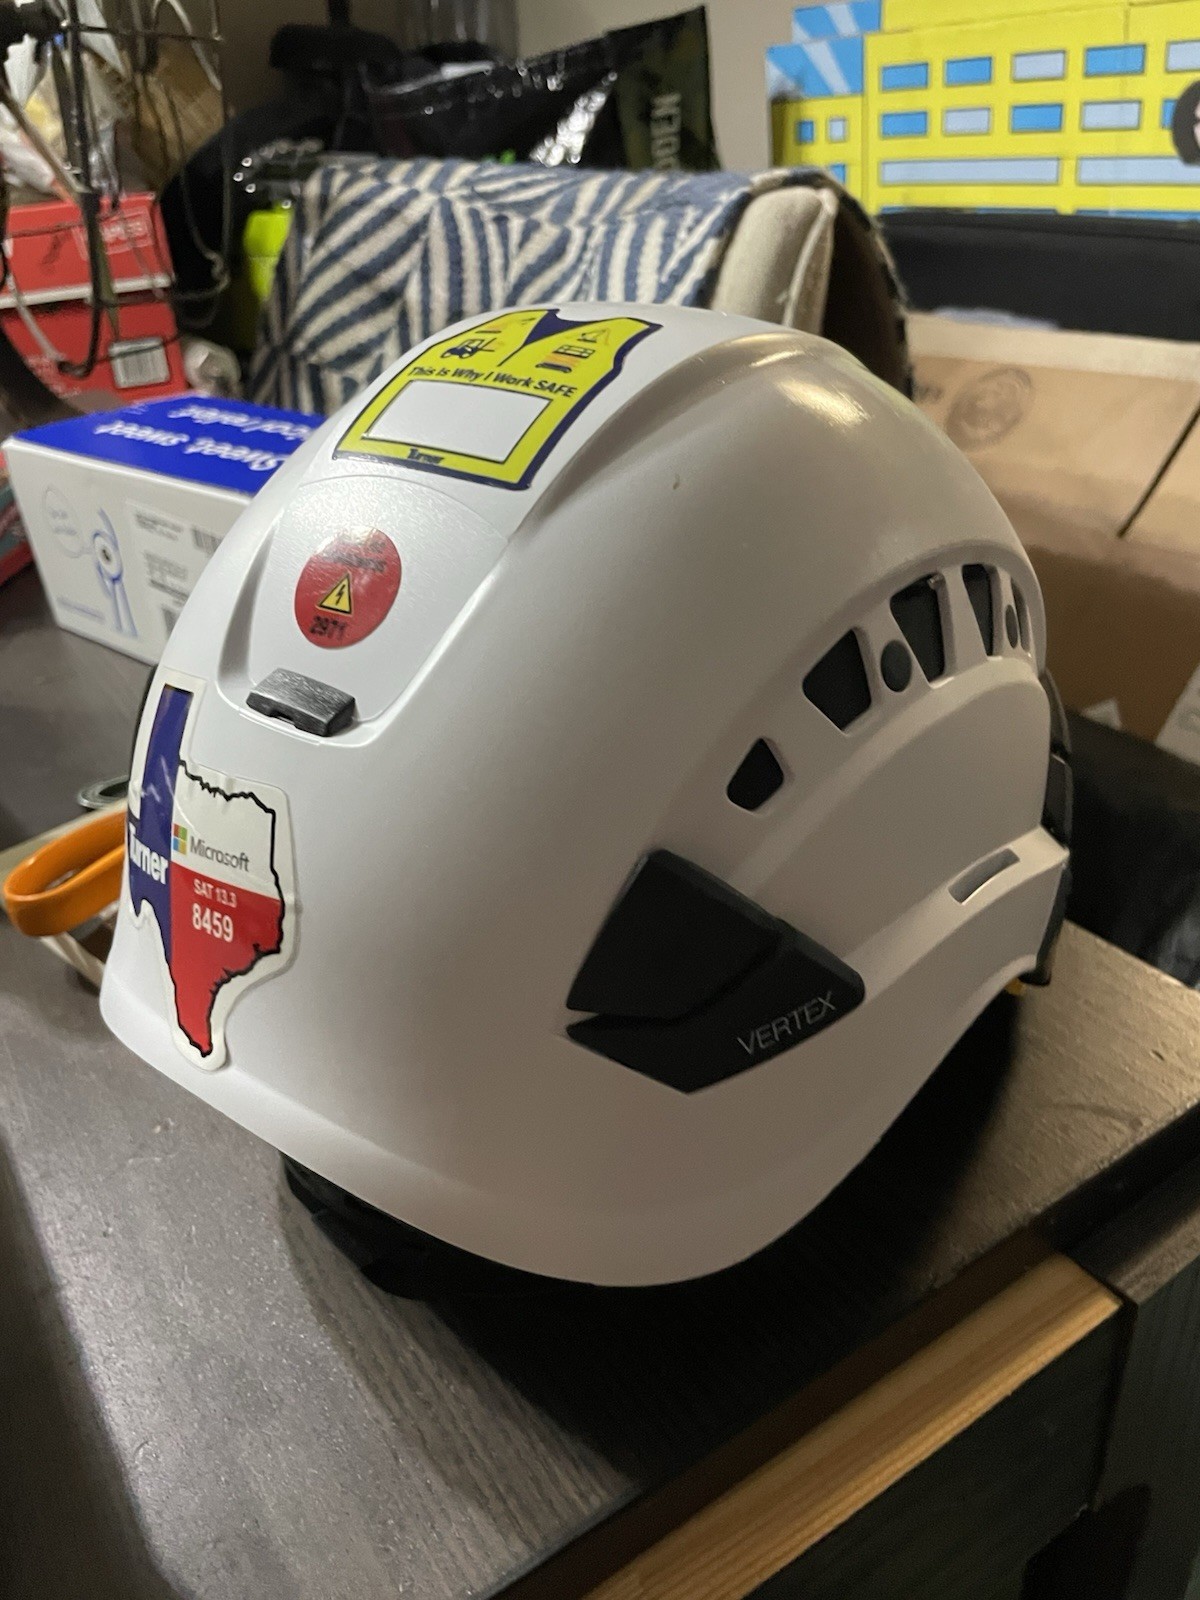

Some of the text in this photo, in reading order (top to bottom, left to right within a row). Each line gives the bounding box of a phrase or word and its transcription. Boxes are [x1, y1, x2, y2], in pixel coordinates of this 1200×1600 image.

[408, 366, 436, 376] This
[452, 367, 483, 382] Why
[484, 371, 494, 381] I
[494, 372, 534, 388] Work
[534, 379, 578, 398] SAFE
[190, 836, 250, 872] Microsoft
[193, 878, 237, 908] SAT 13.3
[192, 902, 234, 943] 8459
[737, 990, 836, 1055] VERTEX
